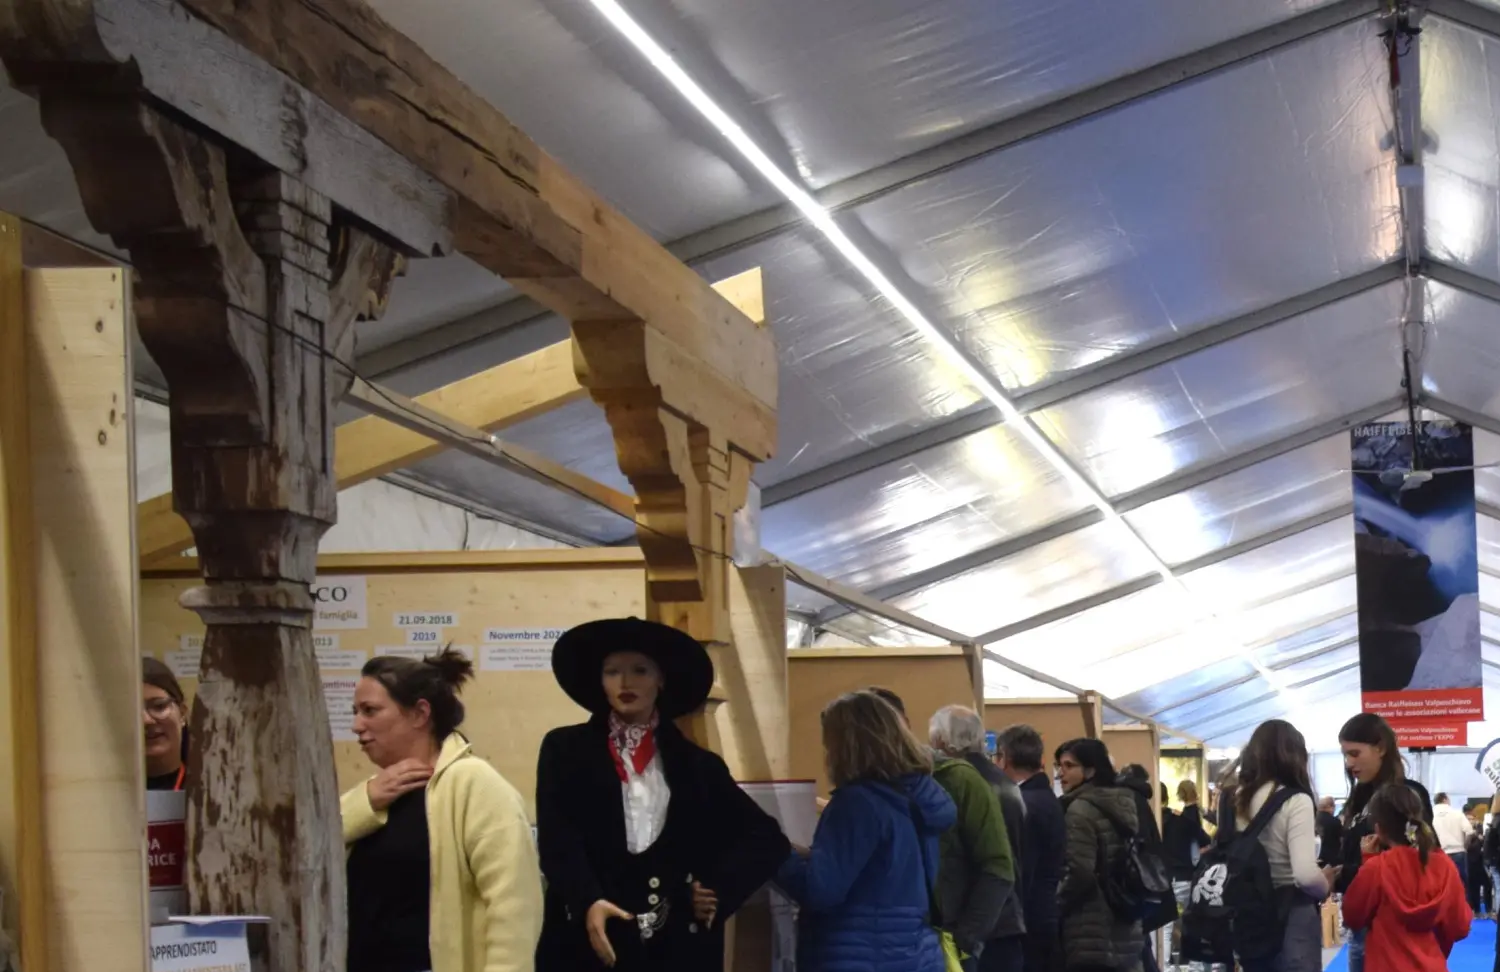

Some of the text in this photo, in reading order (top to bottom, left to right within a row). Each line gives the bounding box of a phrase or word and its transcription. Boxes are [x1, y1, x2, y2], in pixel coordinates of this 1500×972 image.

[1354, 424, 1423, 438] RAIFFEISEN
[399, 615, 453, 625] 21.09.2018
[412, 631, 437, 641] 2019
[489, 630, 541, 641] Novembre
[313, 637, 333, 647] 013
[322, 679, 357, 689] ontinua
